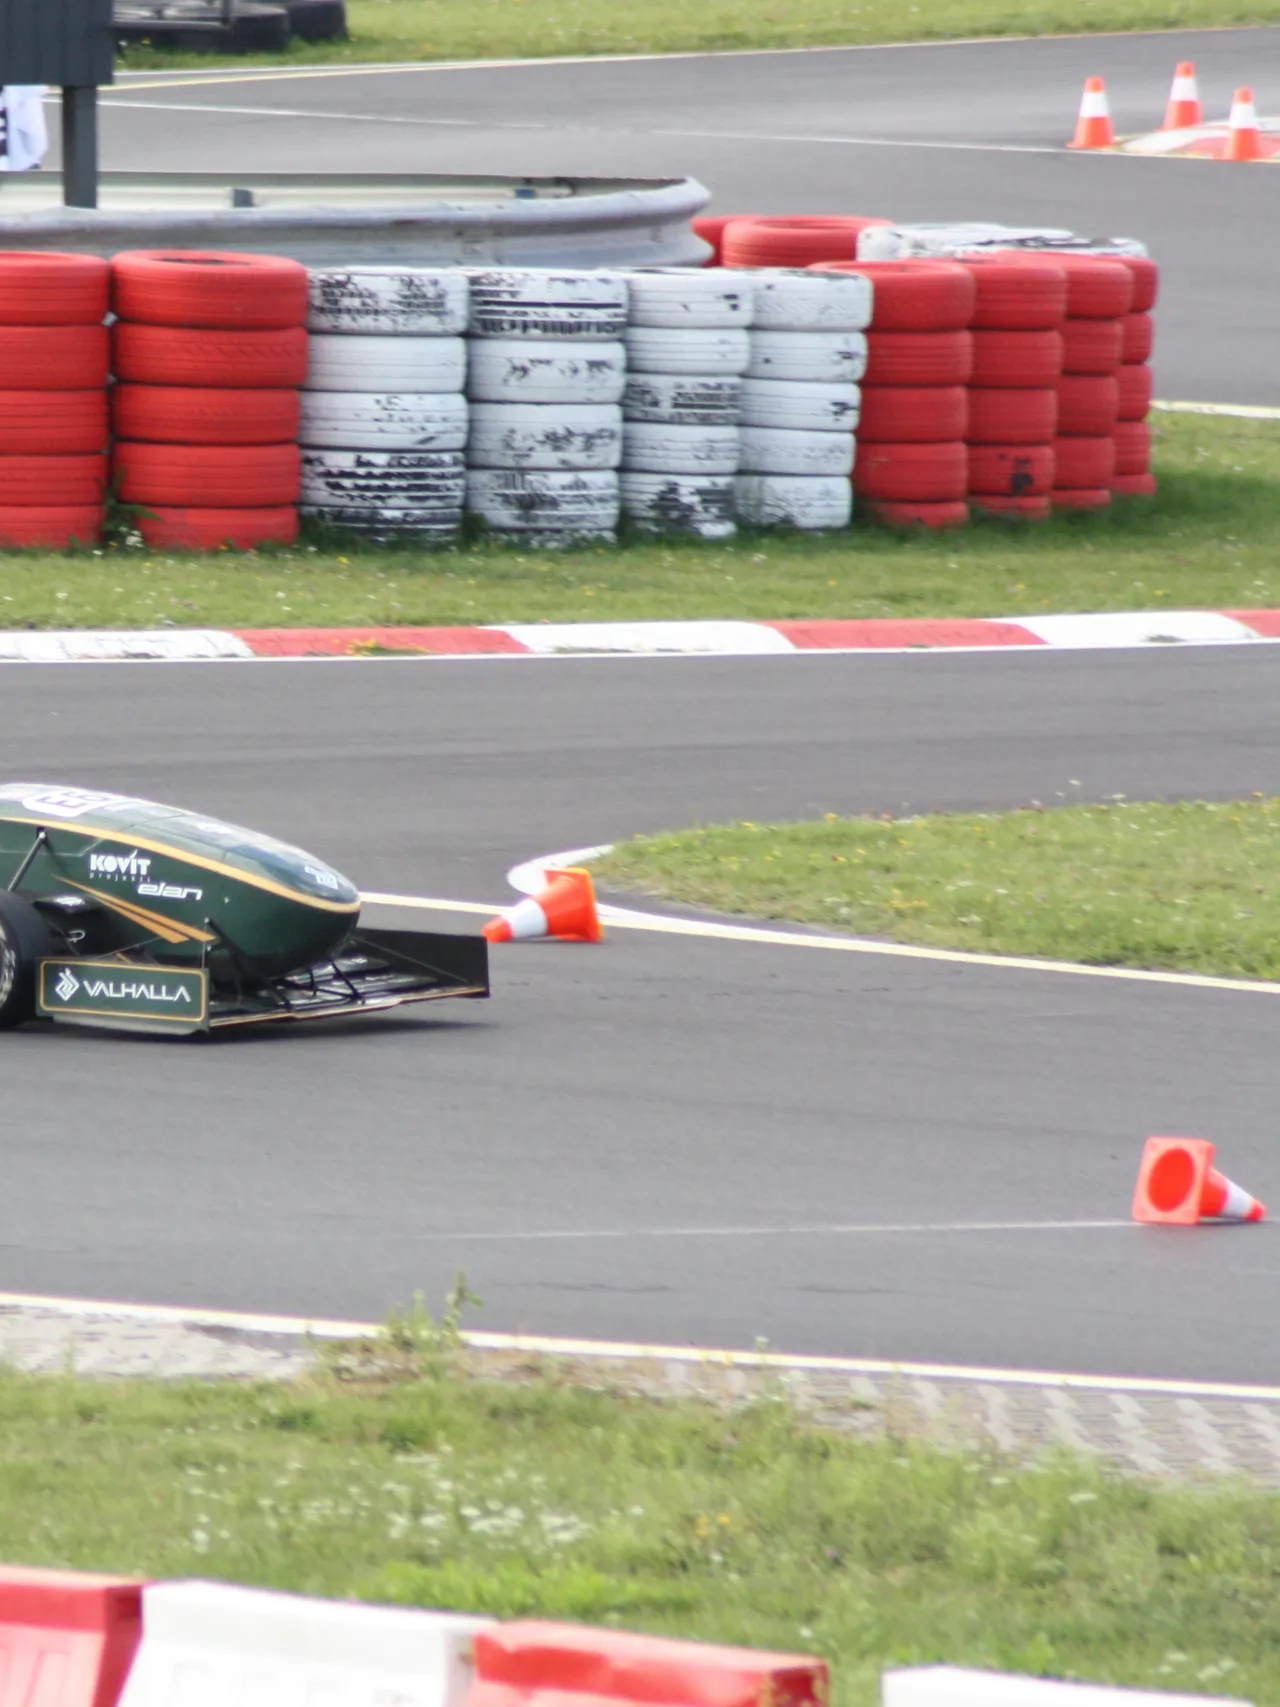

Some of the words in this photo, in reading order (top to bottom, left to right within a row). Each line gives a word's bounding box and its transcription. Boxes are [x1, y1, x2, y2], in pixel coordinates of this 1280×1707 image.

[90, 849, 151, 875] KOVIT
[137, 882, 203, 900] elan
[83, 980, 191, 1003] VALHALLA
